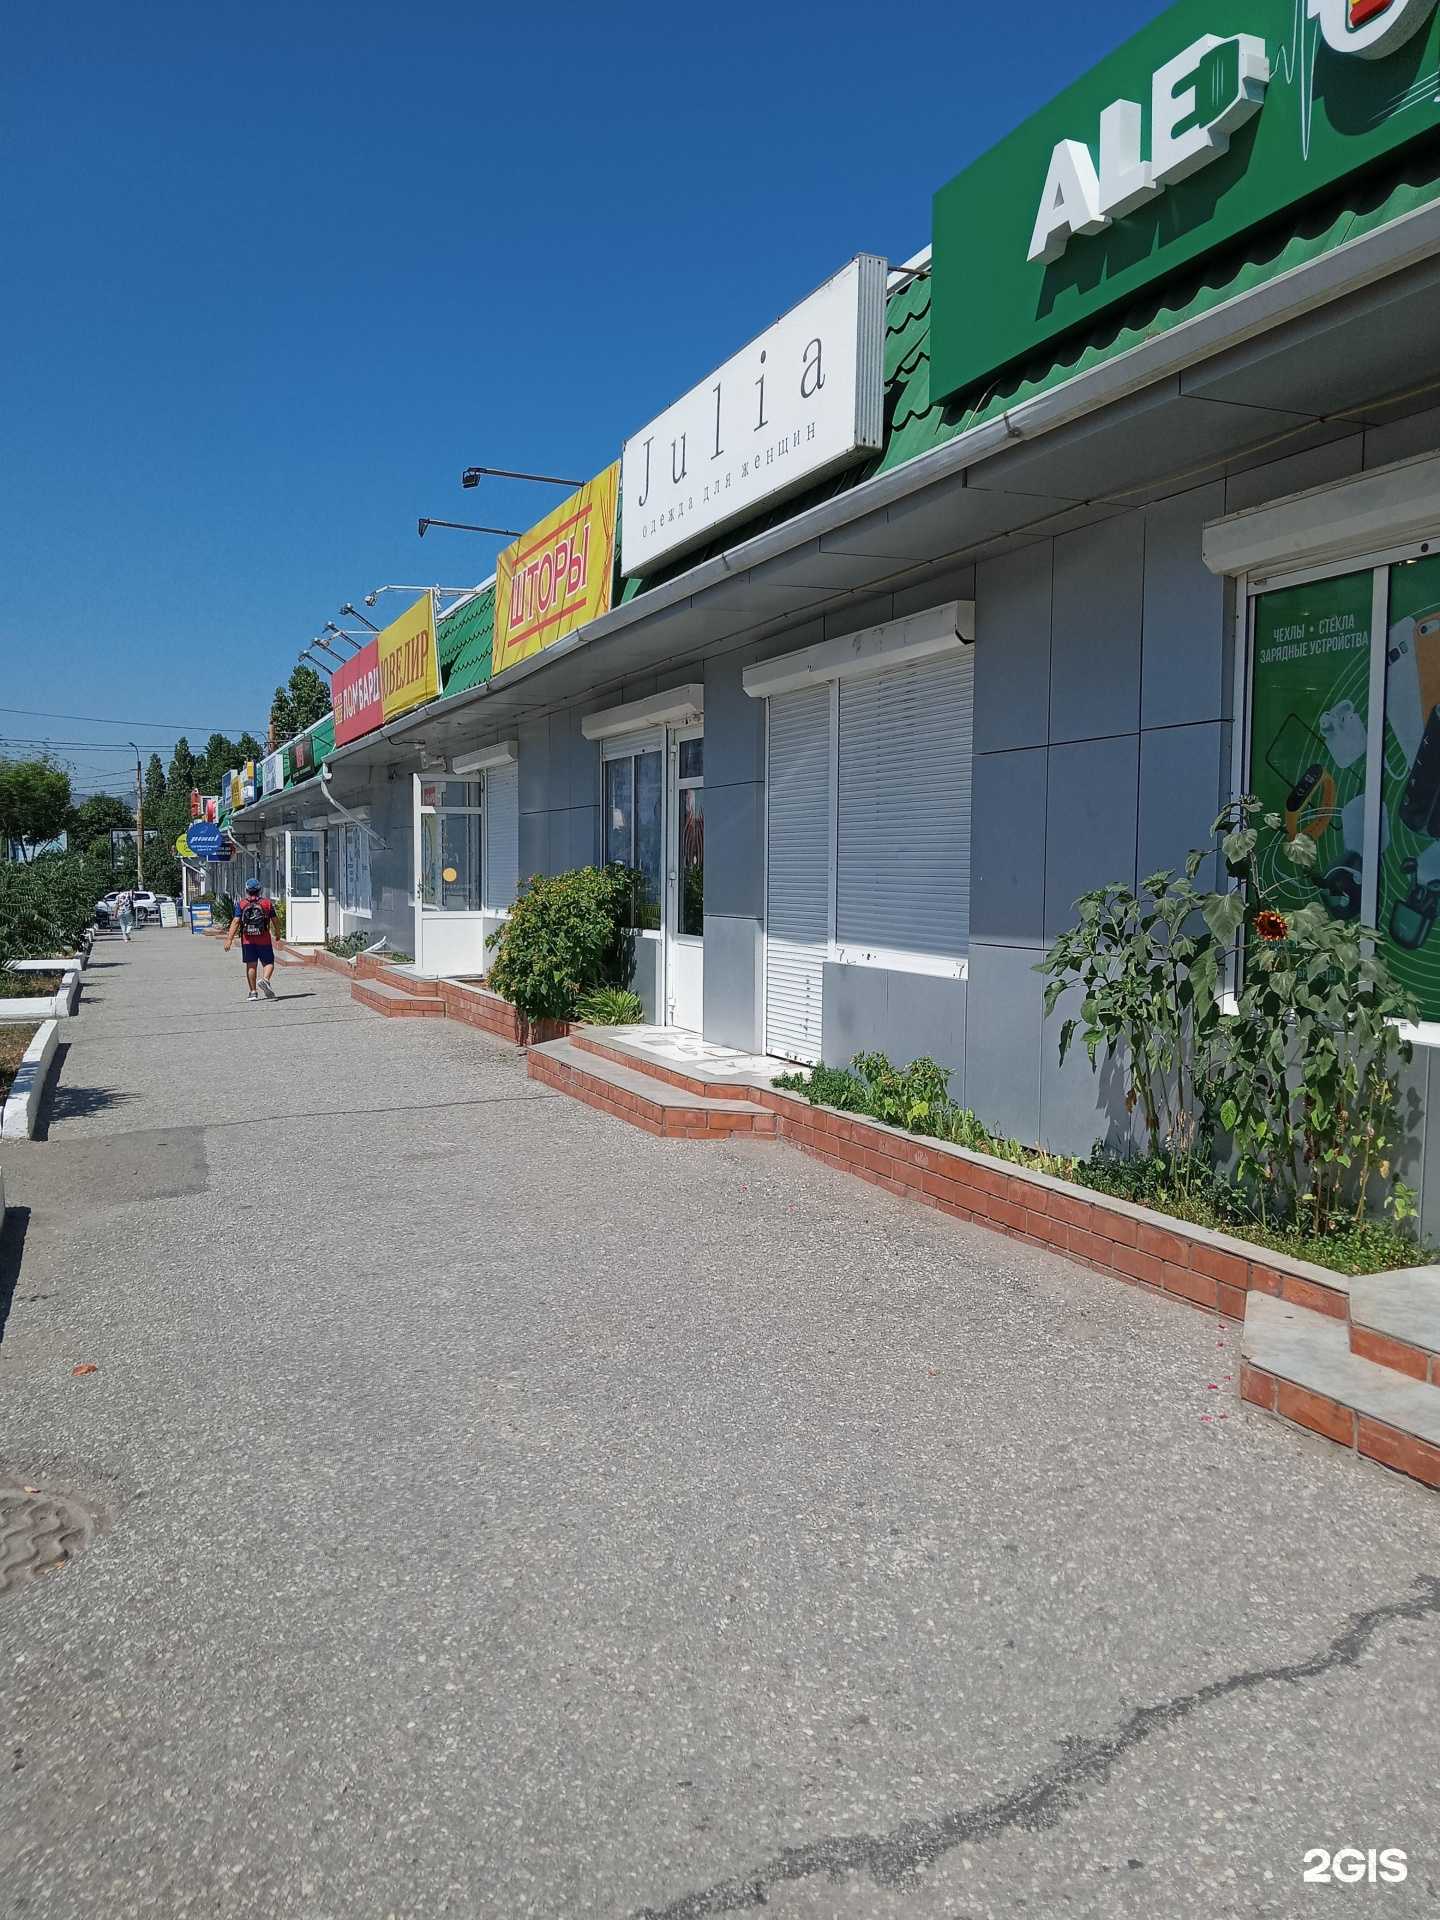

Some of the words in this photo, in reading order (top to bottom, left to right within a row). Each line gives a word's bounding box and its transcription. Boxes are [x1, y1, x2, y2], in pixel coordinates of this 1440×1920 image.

[638, 338, 826, 507] Julia
[642, 495, 694, 538] одежда
[703, 471, 731, 503] для
[741, 422, 816, 478] женщин
[509, 523, 592, 632] ШТОРЫ
[381, 629, 429, 700] ЮВЕЛИР
[1259, 642, 1308, 664] ЗАРЯДНЫЕ
[1308, 631, 1369, 655] УСТРОЙСТВА
[1273, 624, 1305, 642] ЧЕХЛЫ
[1319, 614, 1355, 634] СТЕКЛА
